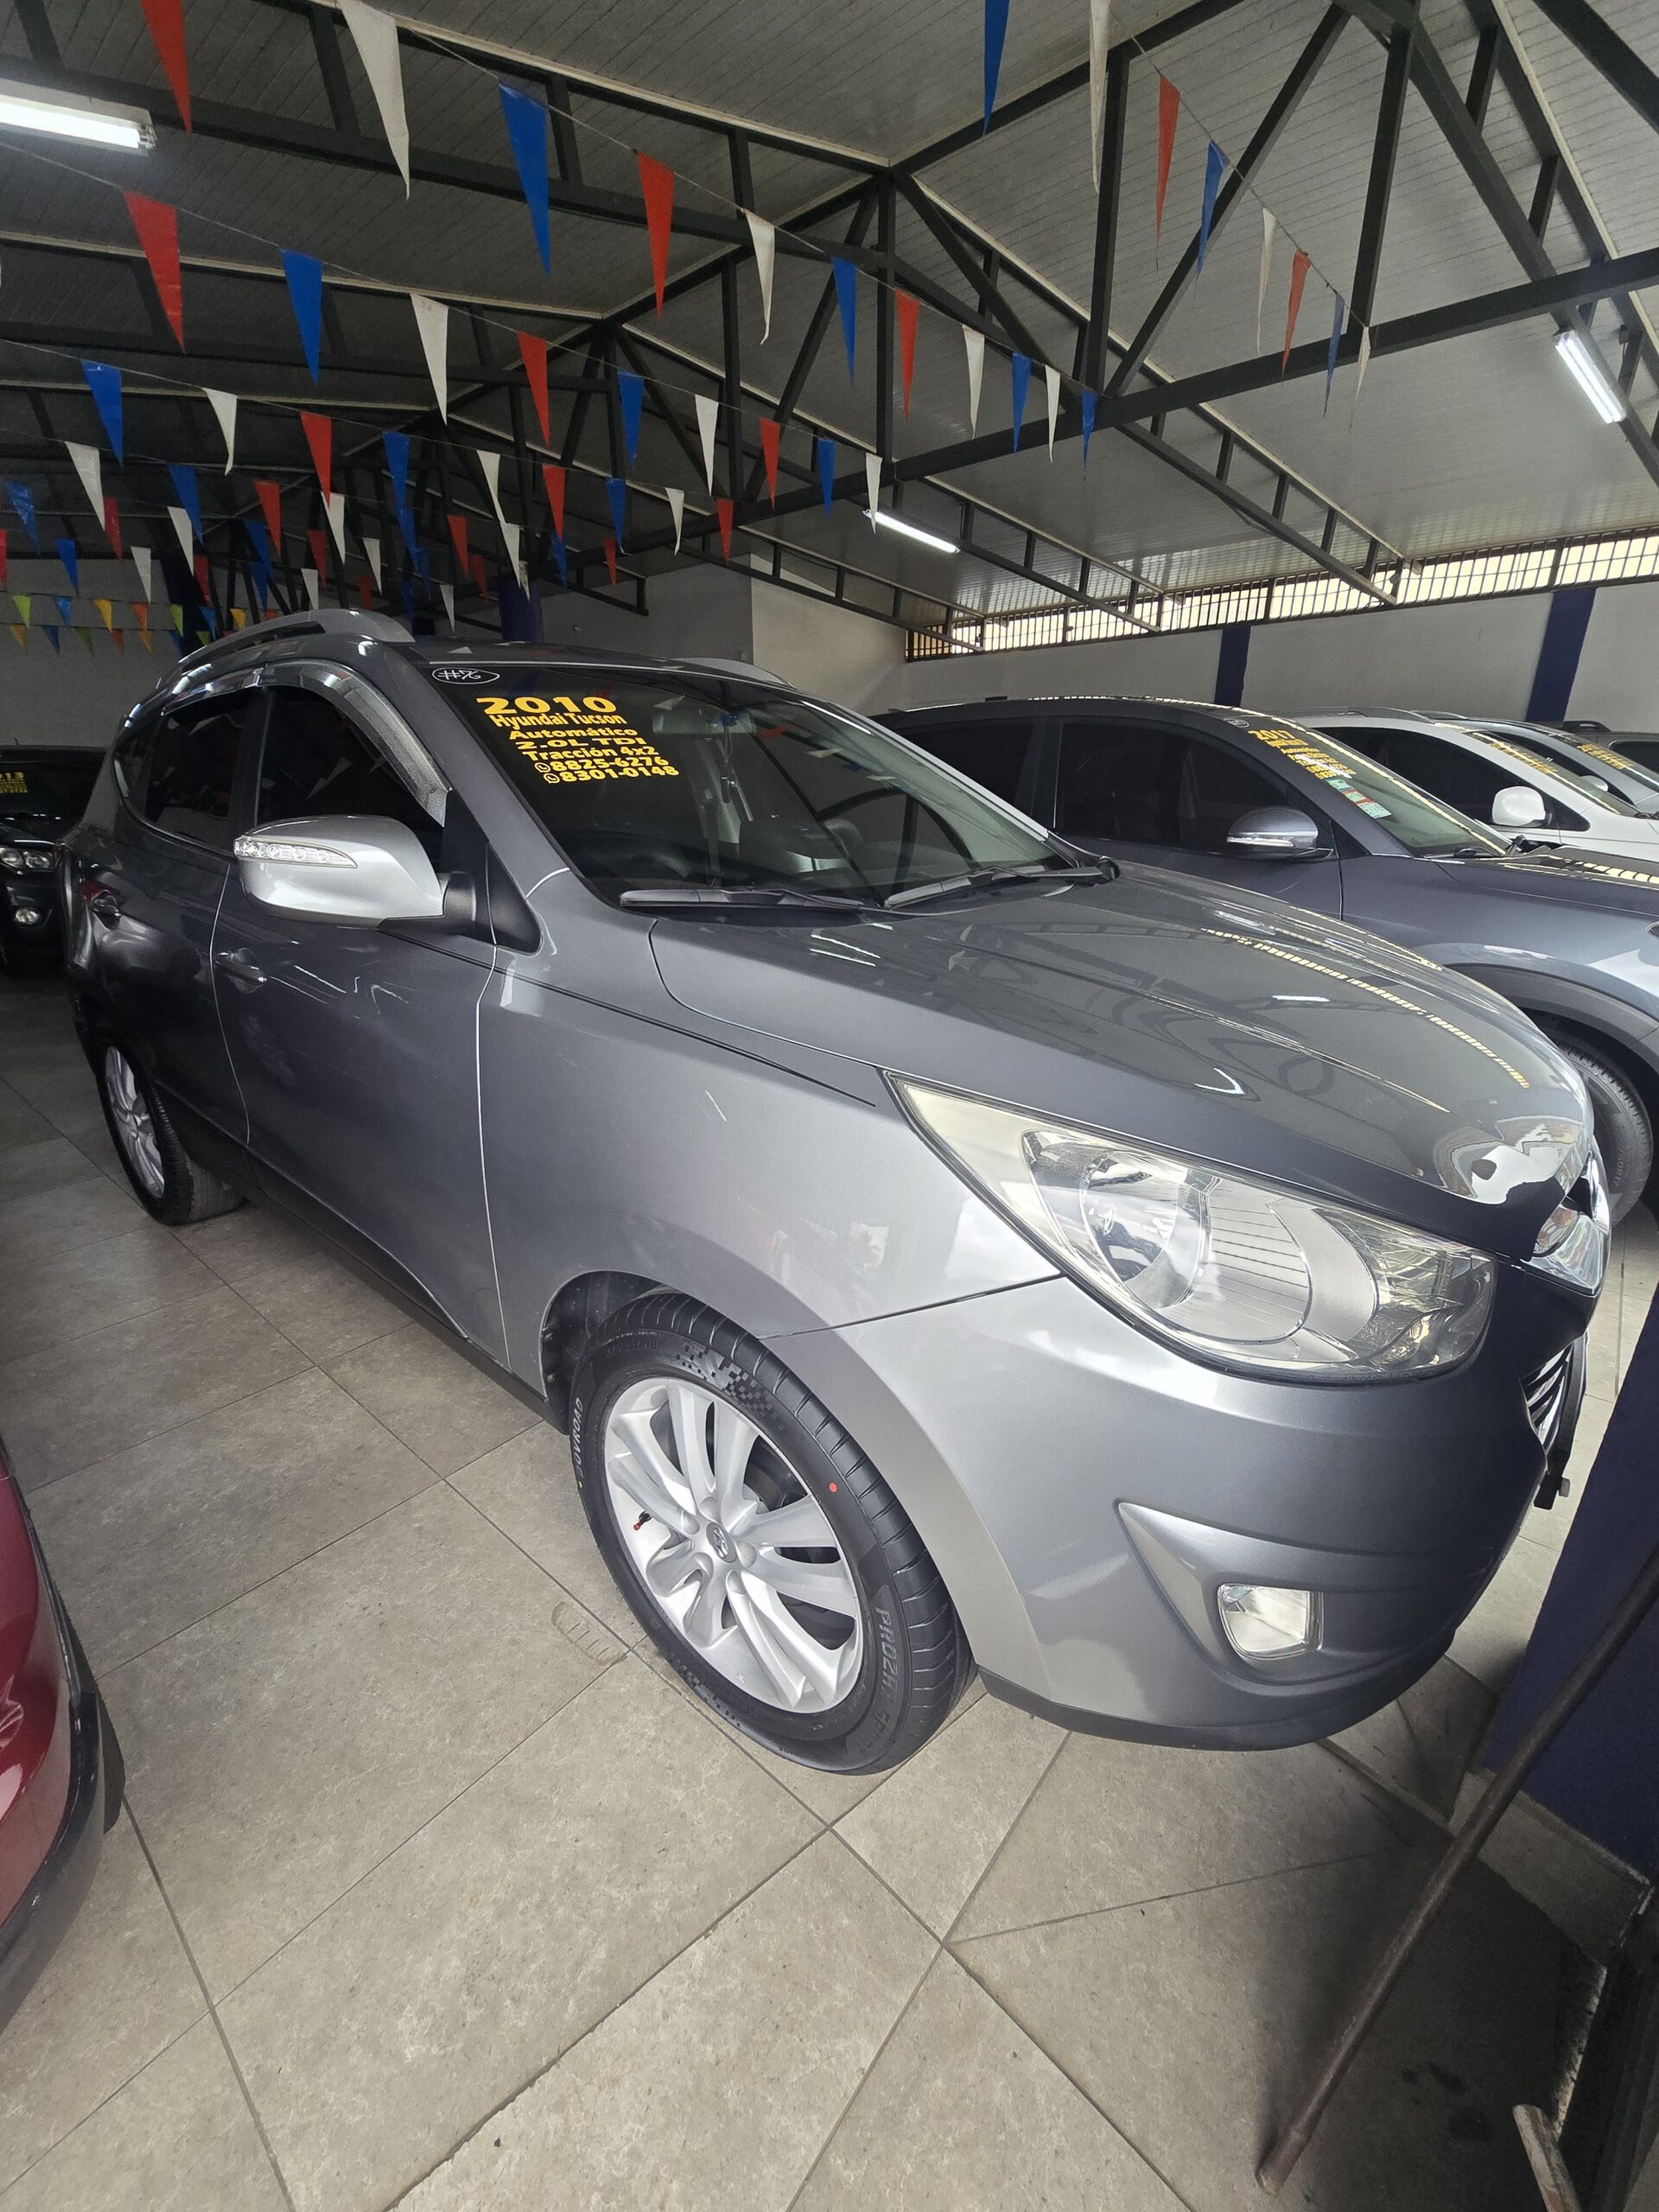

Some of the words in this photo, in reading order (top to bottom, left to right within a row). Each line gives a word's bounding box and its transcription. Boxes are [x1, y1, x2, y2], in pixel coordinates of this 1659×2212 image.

[476, 696, 617, 715] 2010
[488, 713, 569, 730] Hyundai
[563, 712, 627, 725] Tucson
[510, 728, 639, 740] Automático
[515, 739, 589, 750] 2.0L
[592, 737, 647, 746] TDI
[522, 747, 618, 761] Tracción
[620, 746, 659, 756] 4x2
[550, 756, 670, 772] 8825-6276
[559, 766, 679, 782] 8301-0148
